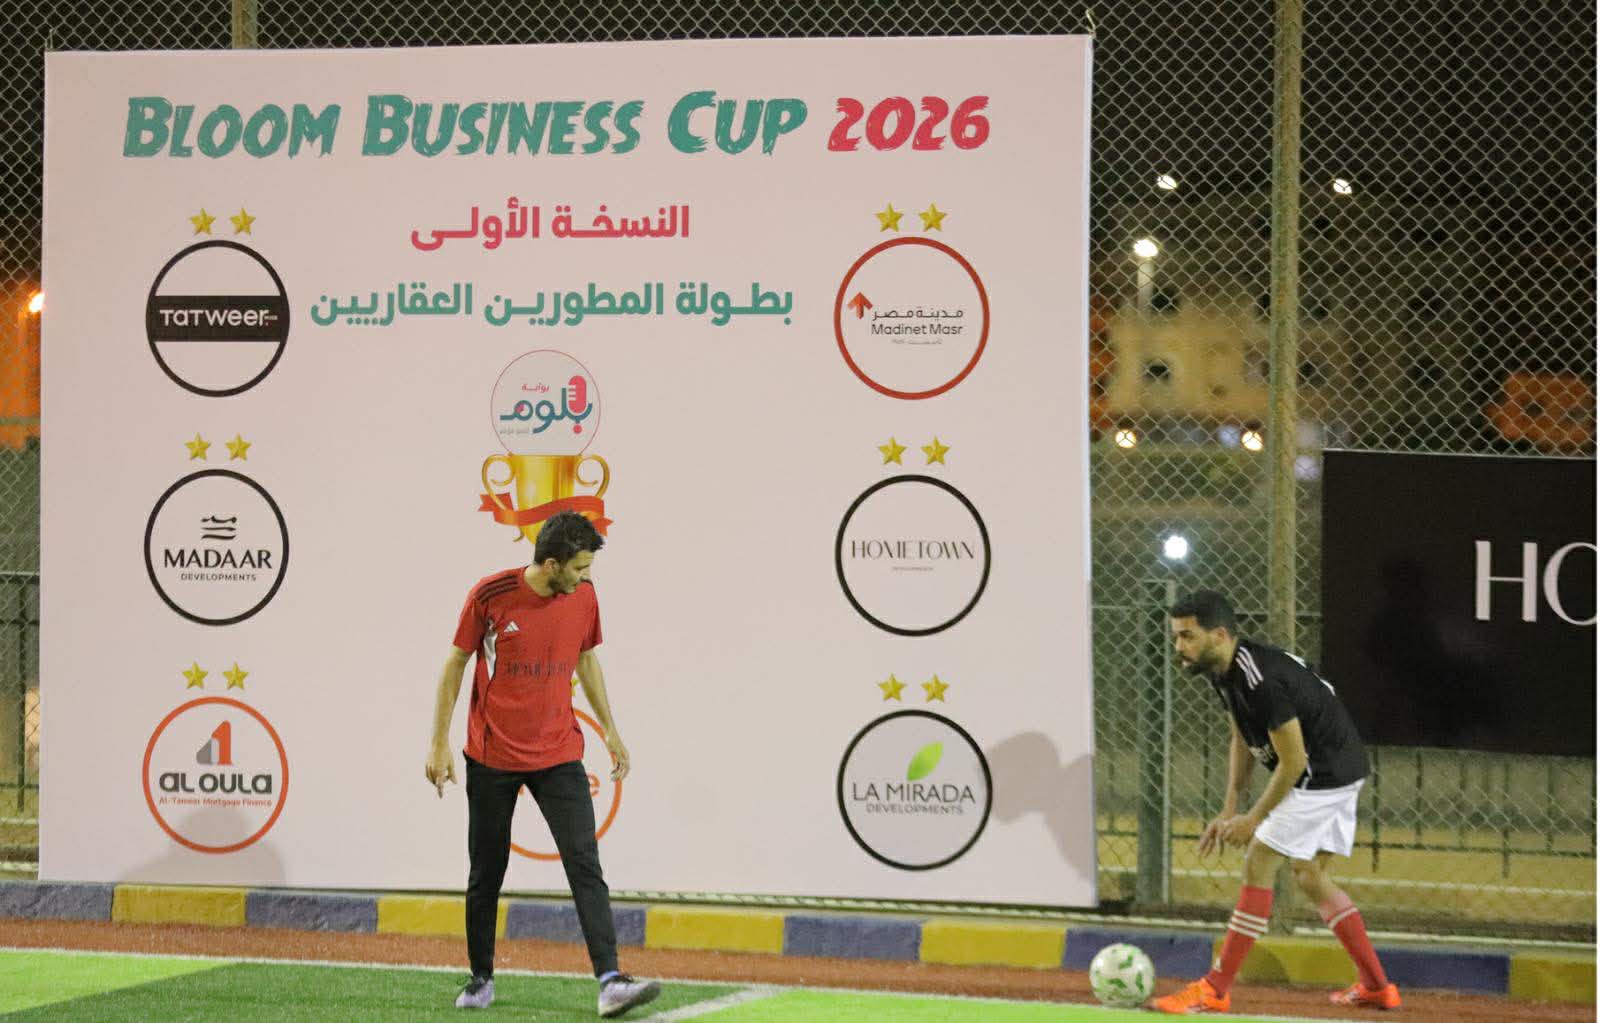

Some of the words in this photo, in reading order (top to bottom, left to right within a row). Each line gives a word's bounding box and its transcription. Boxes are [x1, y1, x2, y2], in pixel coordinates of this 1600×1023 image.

[122, 96, 341, 158] BLOOM
[361, 94, 645, 158] BUSINESS
[667, 90, 808, 155] CUP
[827, 95, 991, 152] 2026
[411, 196, 540, 251] الأولى
[551, 203, 690, 239] النسخة
[310, 282, 473, 326] العقاريين
[484, 282, 664, 326] المطورين
[675, 281, 793, 326] بطولة
[916, 305, 964, 321] مدينة
[872, 308, 914, 321] مصر
[871, 323, 927, 336] Madinet
[929, 323, 963, 336] Masr
[164, 549, 272, 569] MADAAR
[852, 540, 975, 560] HOMETOWN
[180, 573, 257, 581] DEVELOPMENTS
[203, 797, 240, 808] Mortgage
[242, 798, 273, 807] Finance
[852, 783, 880, 801] LA
[886, 784, 976, 804] MIRADA
[866, 803, 963, 814] DEVELOPMENTS
